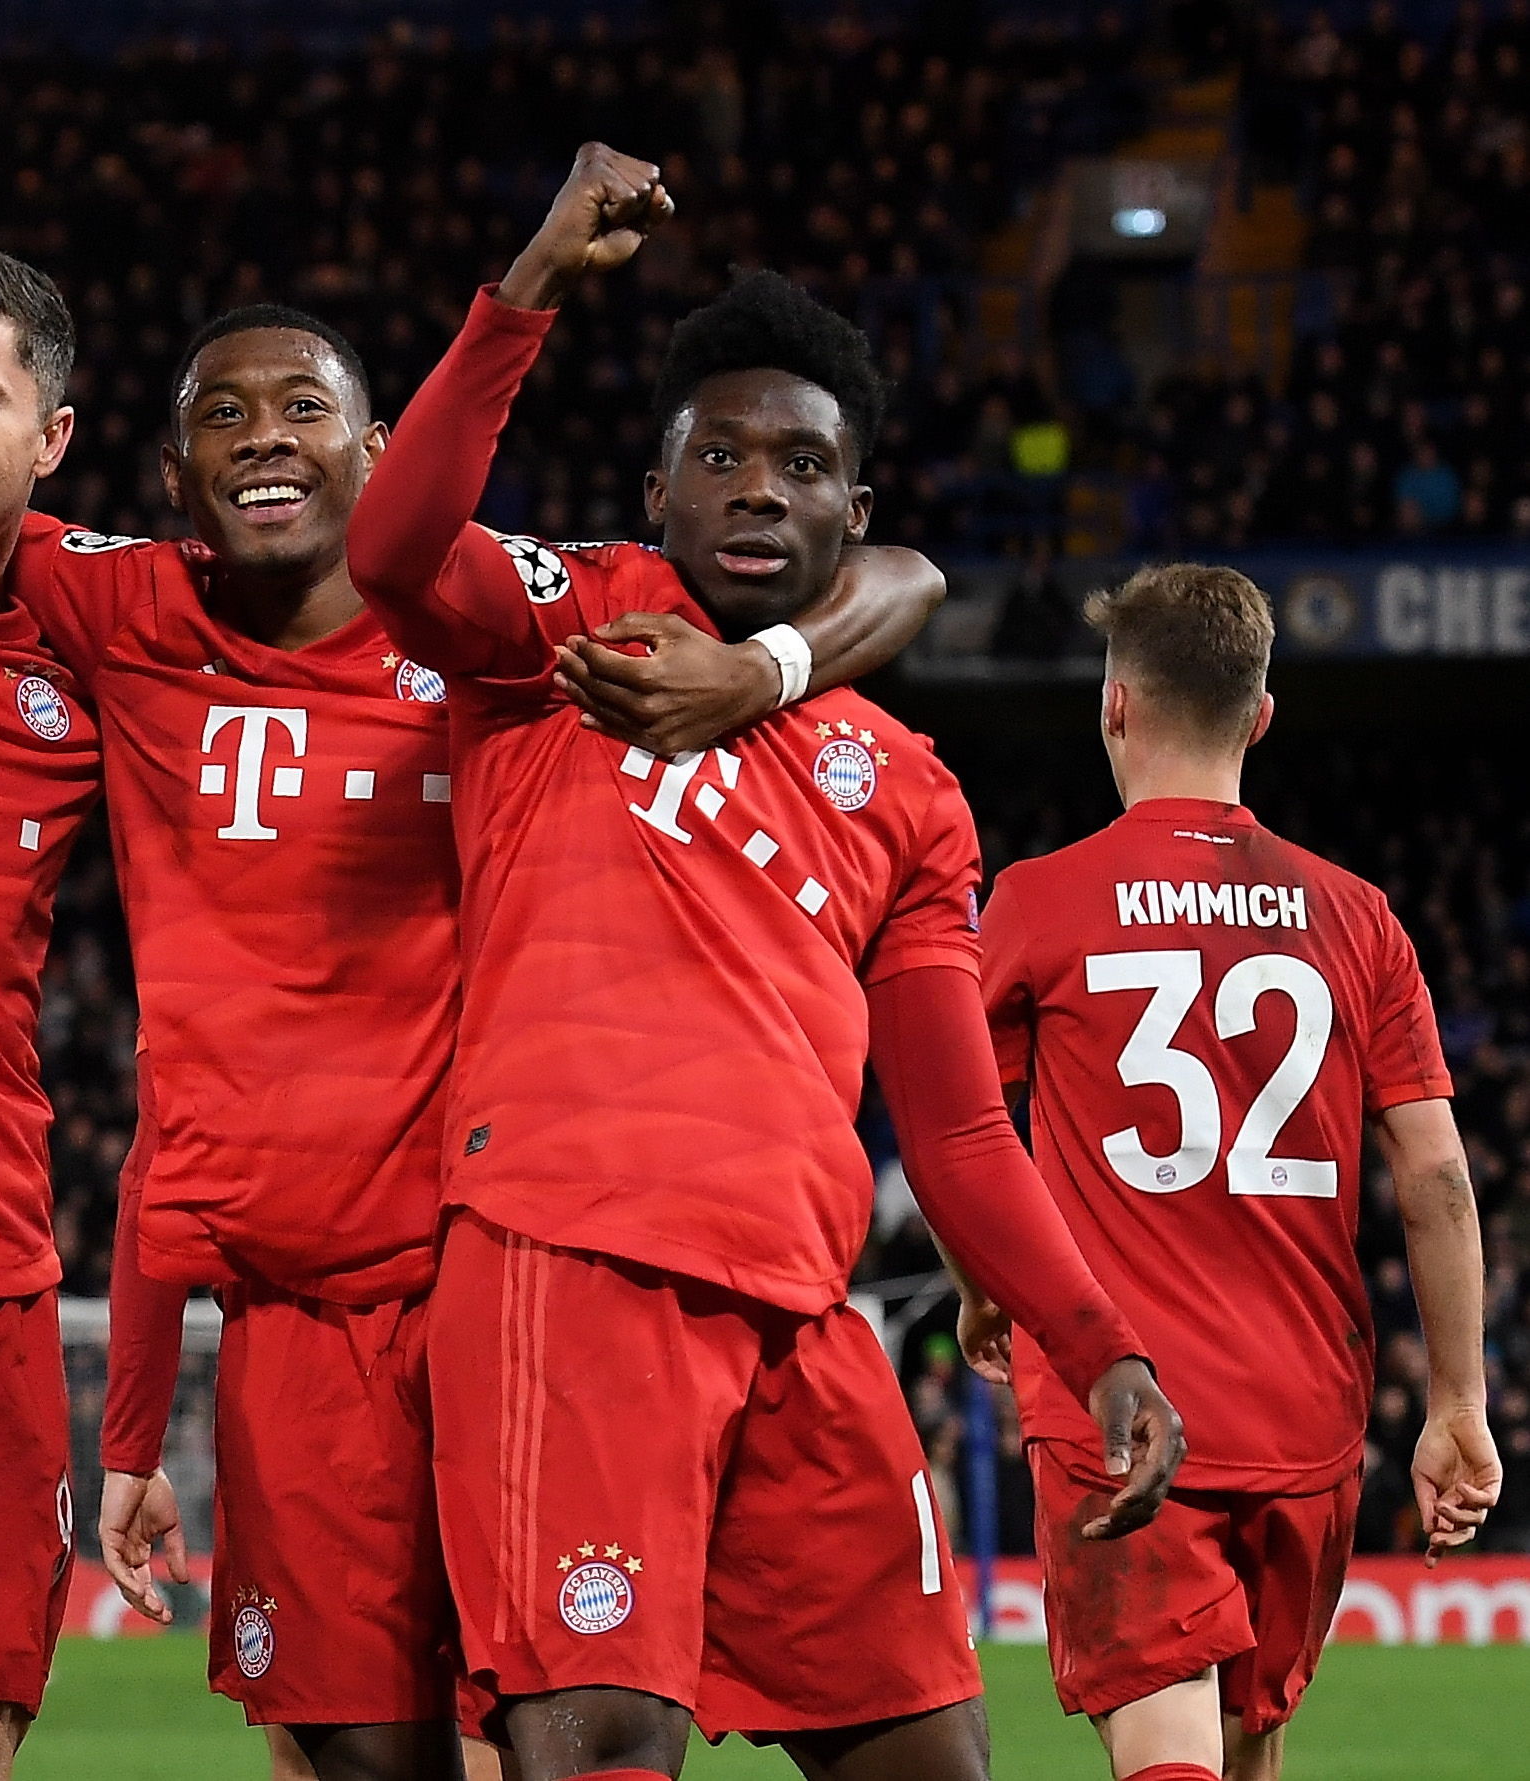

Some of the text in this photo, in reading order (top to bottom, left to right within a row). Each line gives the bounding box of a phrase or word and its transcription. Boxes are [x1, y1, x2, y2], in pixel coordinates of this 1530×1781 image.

[1115, 881, 1308, 930] KIMMICH
[1085, 950, 1337, 1198] 32
[581, 1568, 627, 1596] BAYERN
